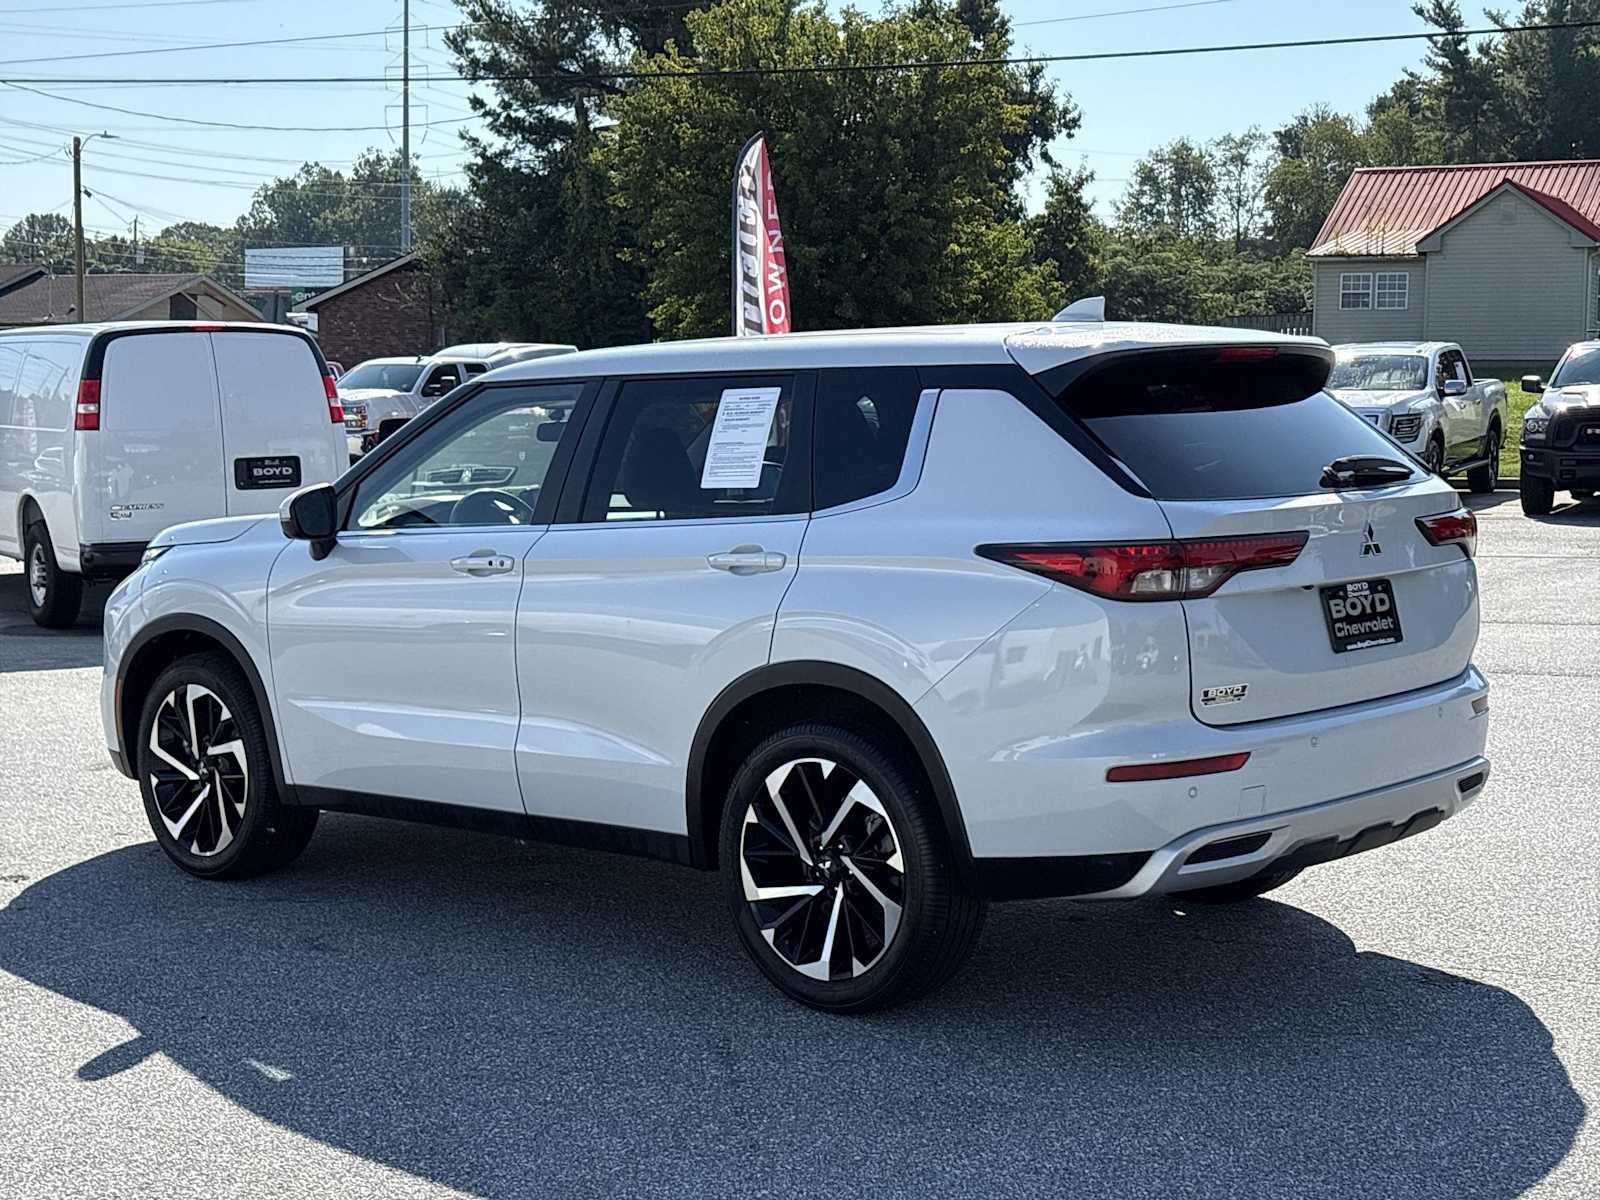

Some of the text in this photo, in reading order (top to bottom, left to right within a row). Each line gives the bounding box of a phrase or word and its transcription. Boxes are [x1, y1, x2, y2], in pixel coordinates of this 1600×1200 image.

[253, 467, 293, 476] BOYD
[1347, 582, 1369, 592] BOYD
[1329, 592, 1390, 619] BOYD
[1334, 616, 1394, 637] Chevrolet
[1209, 686, 1241, 696] BOYD
